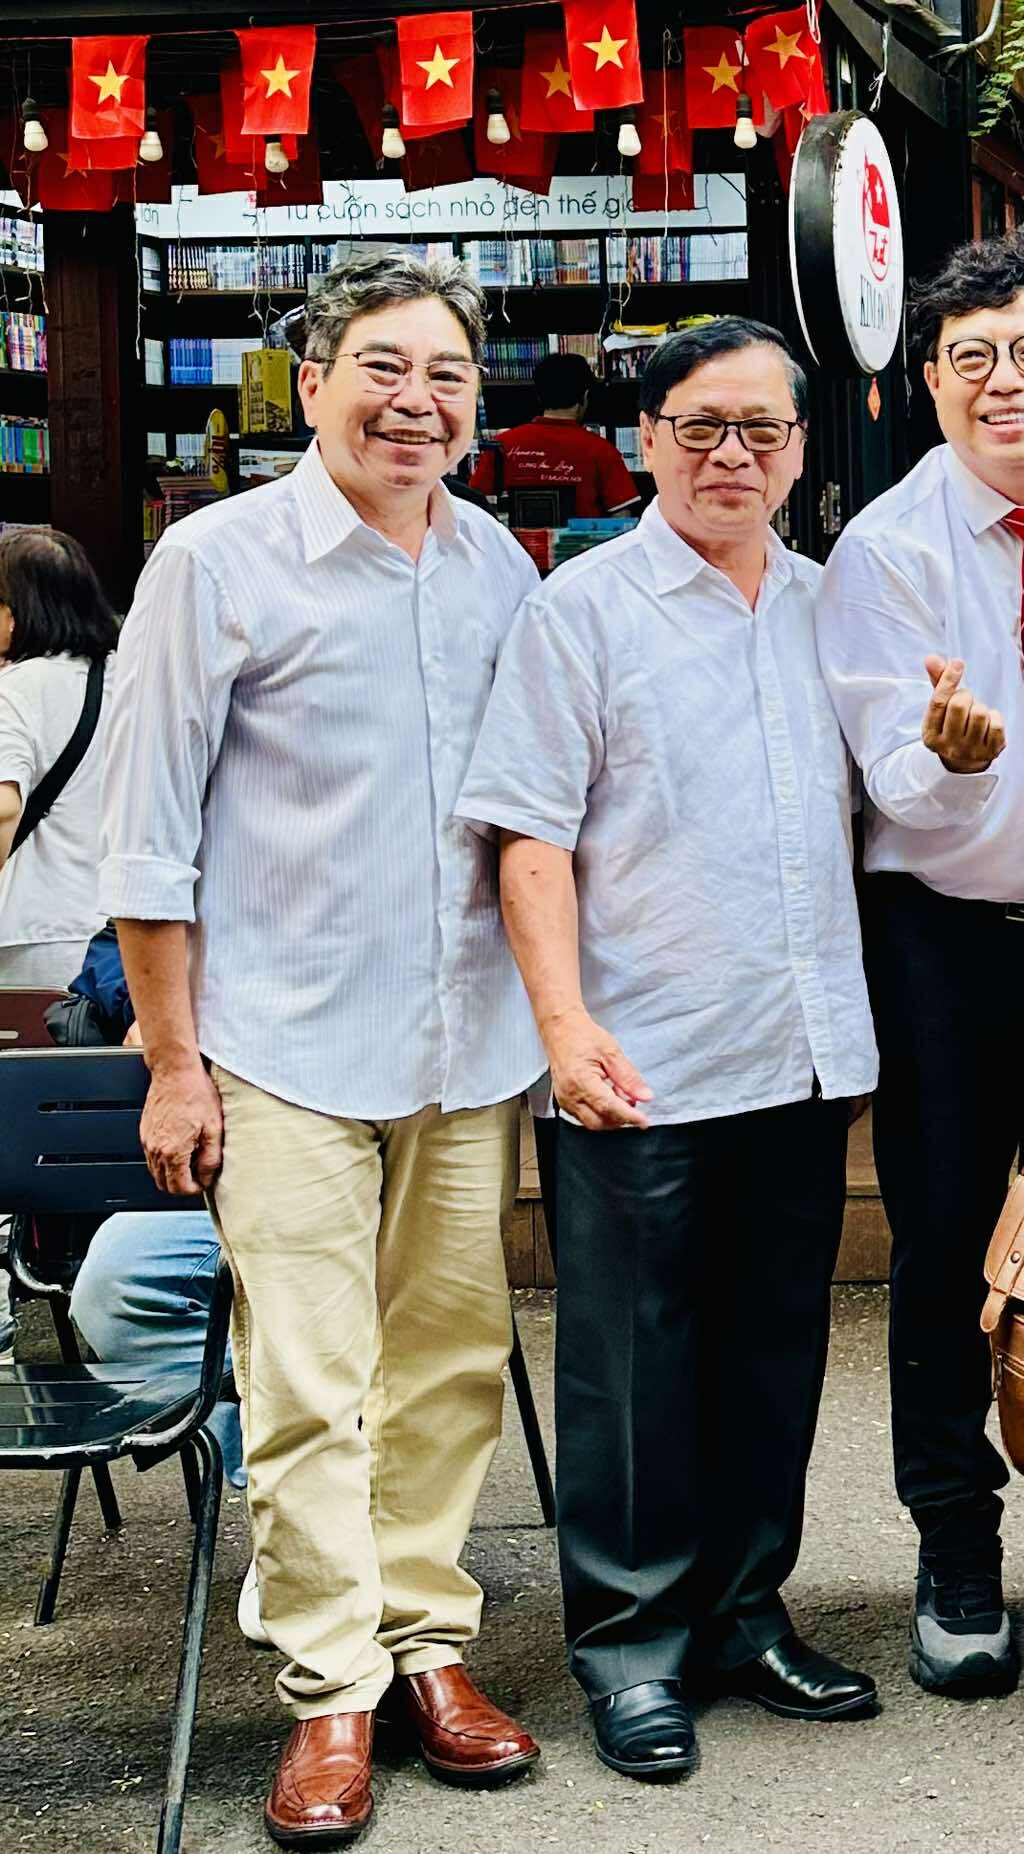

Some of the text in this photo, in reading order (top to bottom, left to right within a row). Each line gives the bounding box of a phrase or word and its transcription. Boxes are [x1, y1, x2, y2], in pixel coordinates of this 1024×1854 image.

[385, 196, 441, 218] sách
[450, 193, 495, 217] nhỏ
[557, 190, 598, 215] thế
